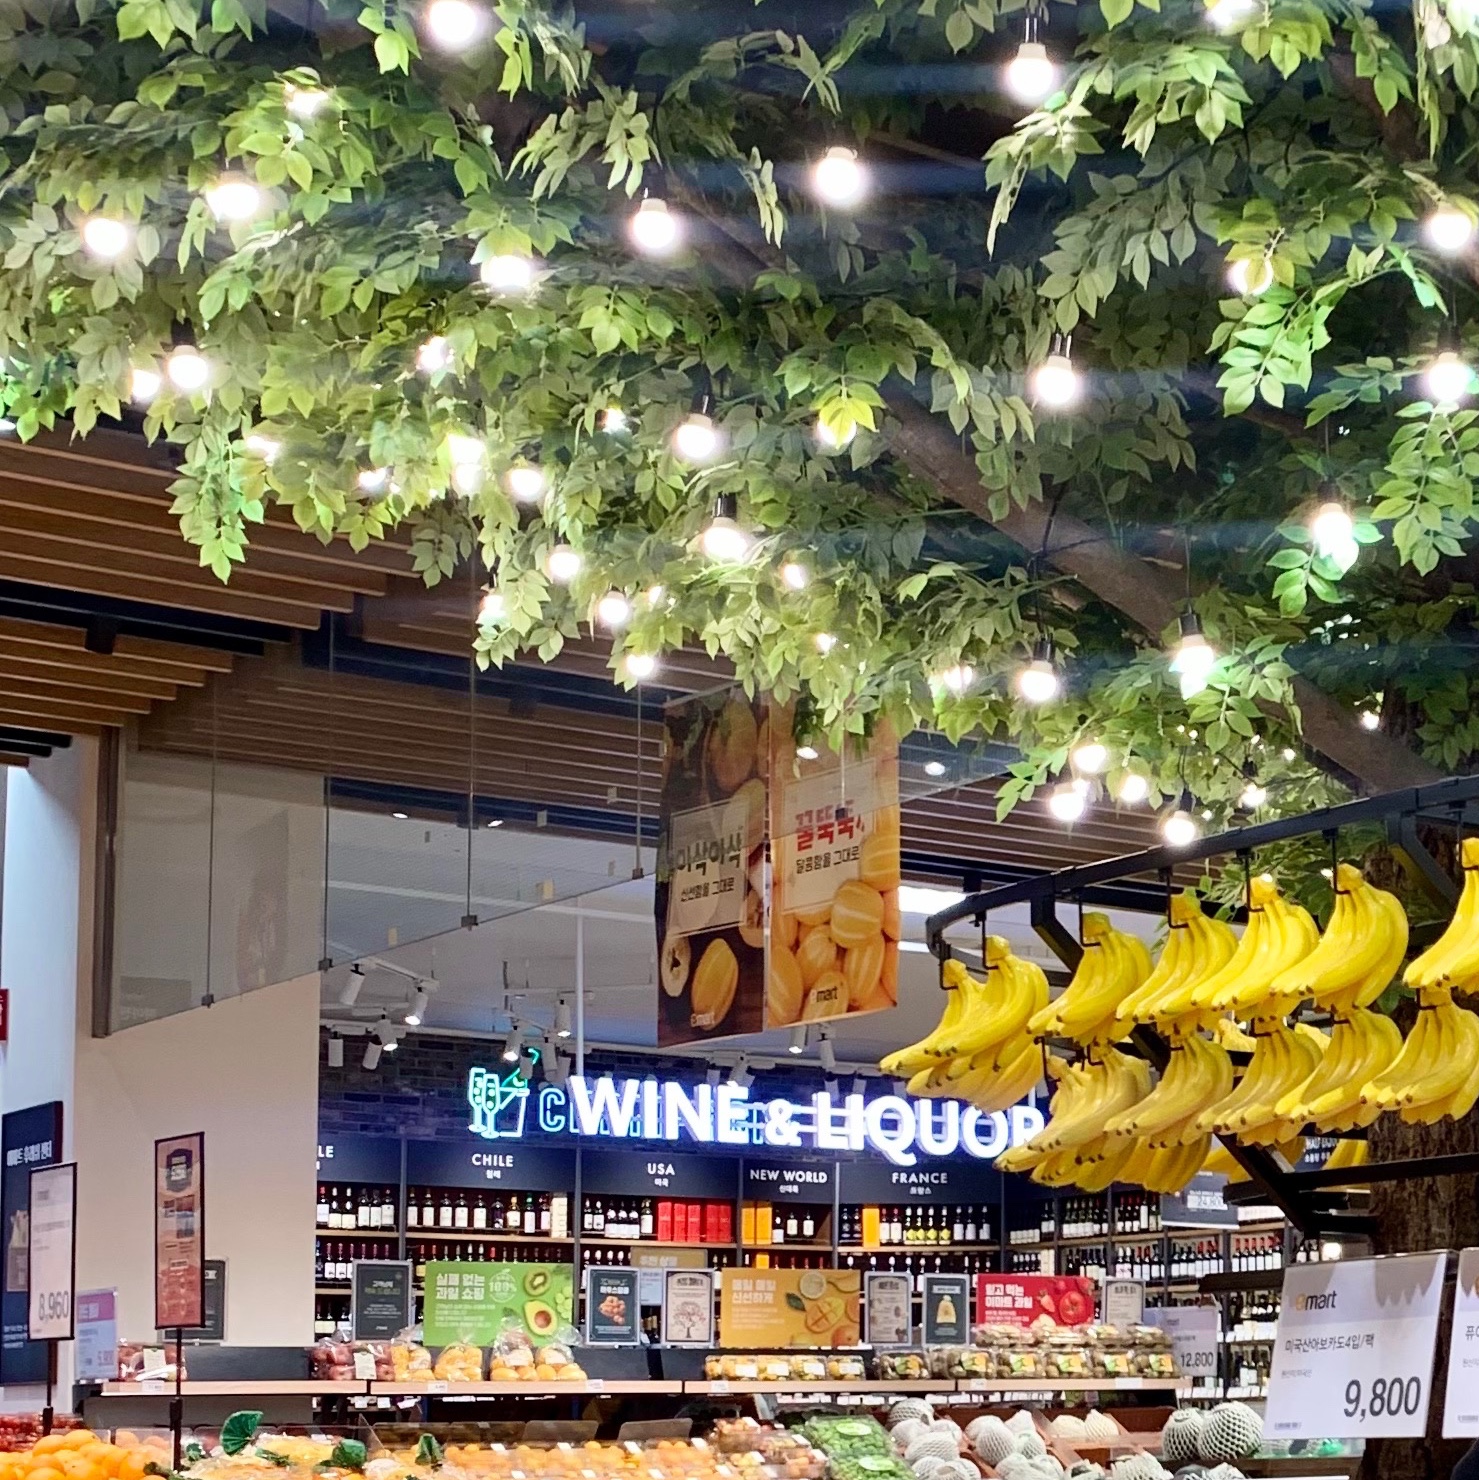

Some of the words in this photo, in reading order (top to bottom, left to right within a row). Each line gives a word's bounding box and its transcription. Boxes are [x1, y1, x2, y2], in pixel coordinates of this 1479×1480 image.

[834, 845, 861, 866] 그대로
[712, 877, 735, 896] 그대로
[567, 1075, 749, 1143] WINE
[763, 1098, 802, 1147] &
[471, 1154, 514, 1168] CHILE
[647, 1163, 675, 1176] USA
[750, 1169, 779, 1181] NEW
[783, 1170, 828, 1184] WORLD
[891, 1172, 948, 1184] FRANCE
[436, 1287, 459, 1301] 과일
[1294, 1290, 1338, 1312] emart
[38, 1289, 70, 1324] 8,960
[1180, 1352, 1214, 1368] 12,800
[1344, 1376, 1422, 1423] 9,800
